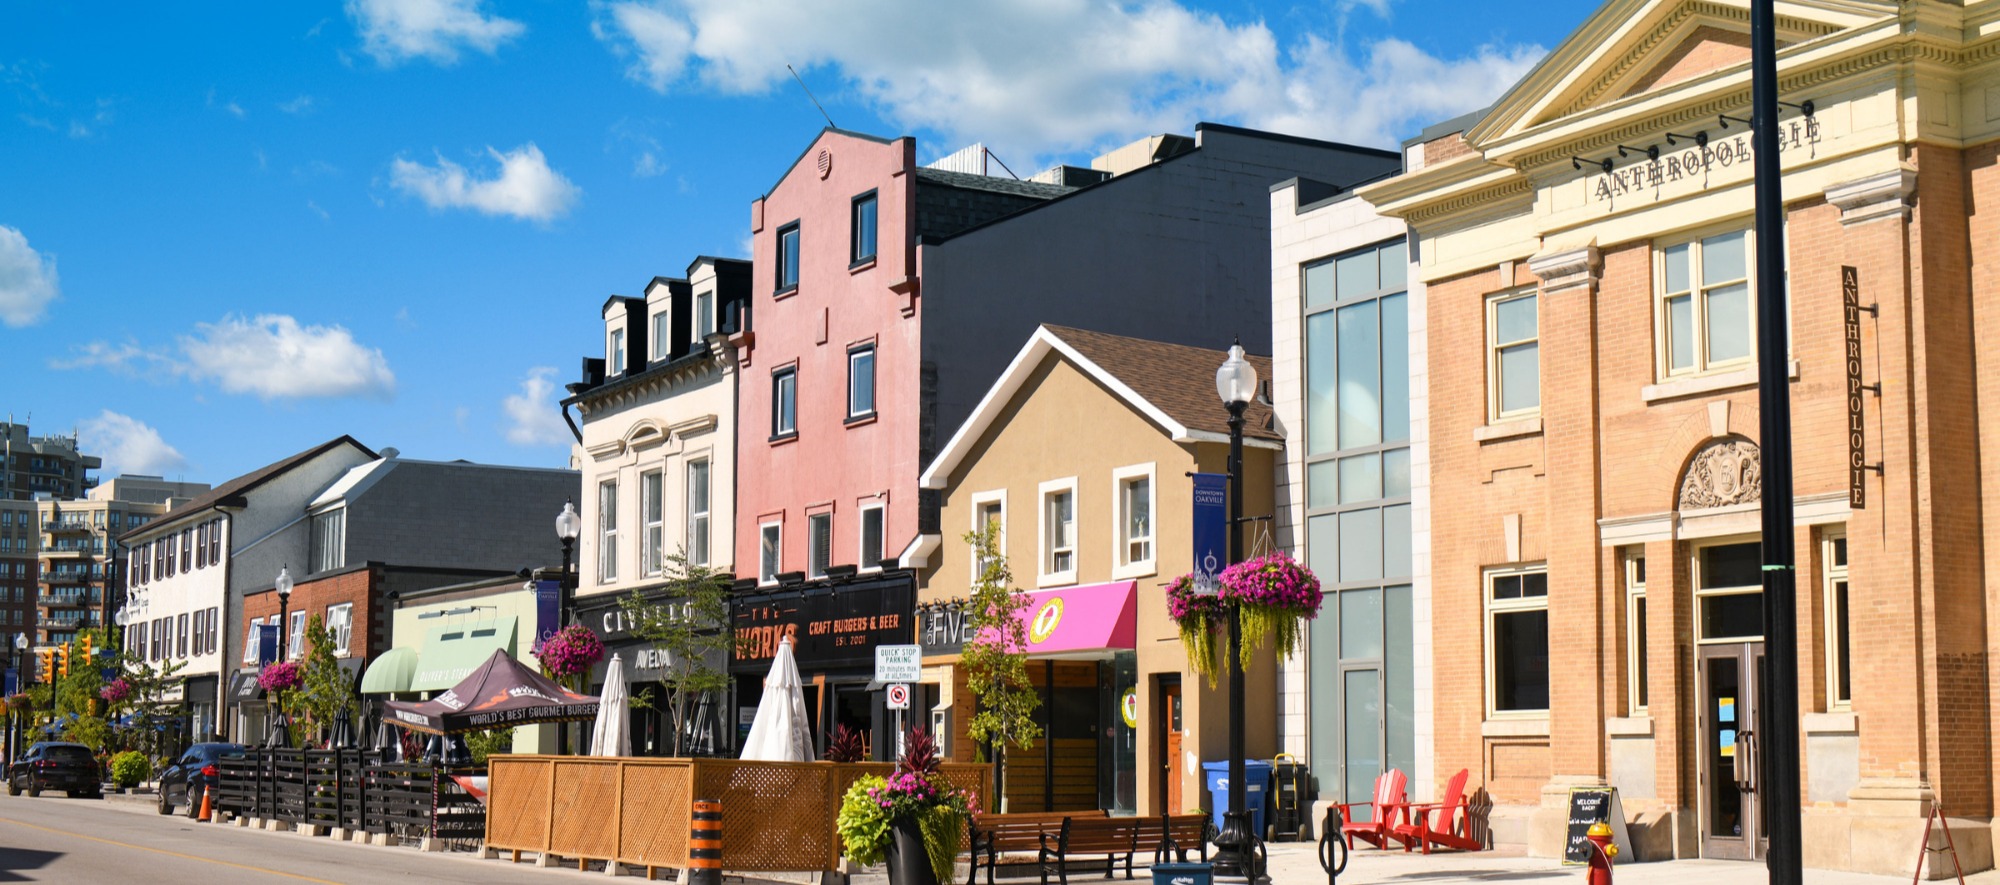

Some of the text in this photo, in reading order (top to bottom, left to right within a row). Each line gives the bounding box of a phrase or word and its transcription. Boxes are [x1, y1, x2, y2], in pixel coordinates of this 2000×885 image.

[1595, 117, 1820, 197] ANTHROPOLIE
[1844, 270, 1863, 505] ANTHROPOLOGIE
[1195, 496, 1223, 504] OAKVILLE
[809, 614, 899, 635] CRAFT BURGERS & BEER
[932, 608, 973, 646] FIVE
[735, 623, 799, 661] WORKS
[850, 635, 866, 645] 2001
[881, 648, 917, 656] QUICK STOP
[469, 711, 505, 726] WORLD'S
[507, 708, 526, 721] BEST
[528, 704, 565, 719] GOURMET
